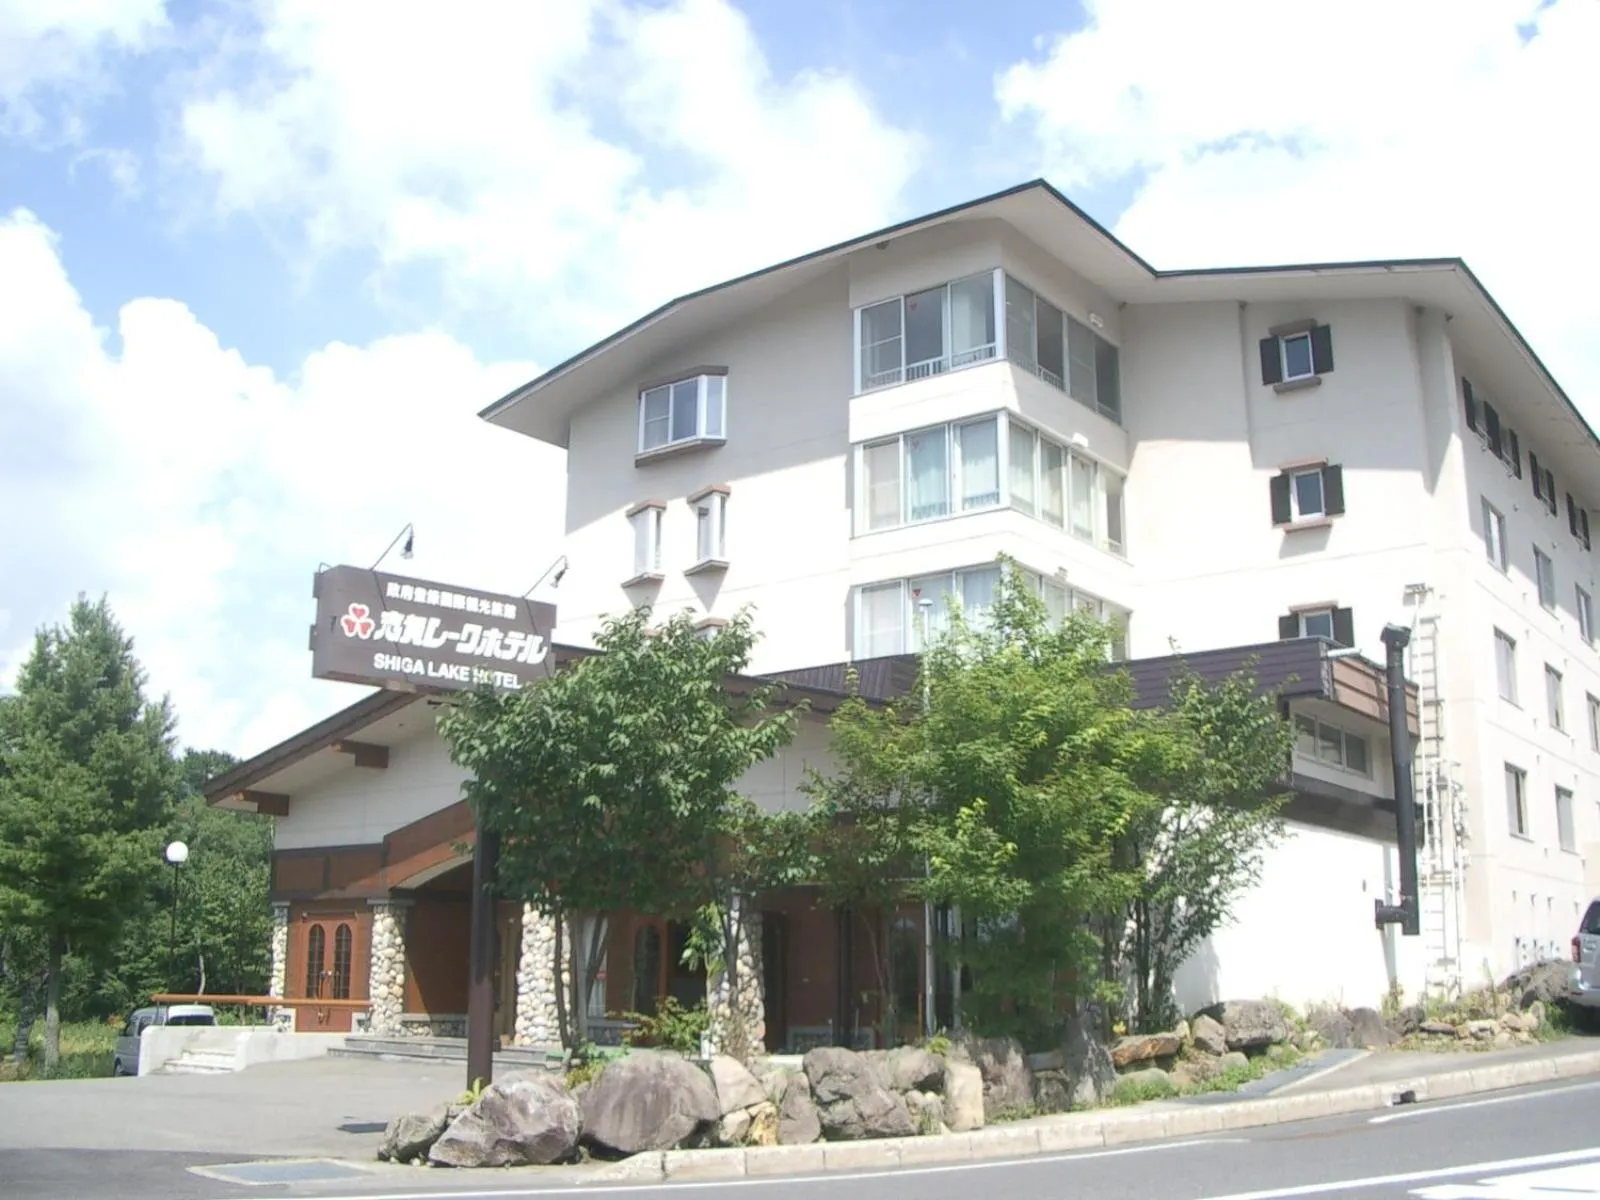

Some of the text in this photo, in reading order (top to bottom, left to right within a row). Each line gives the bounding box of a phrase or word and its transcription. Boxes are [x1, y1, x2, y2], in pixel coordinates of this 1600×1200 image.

[373, 610, 548, 664] 志賀レークホテル
[373, 653, 424, 675] SHIGA
[428, 661, 470, 682] LAKE
